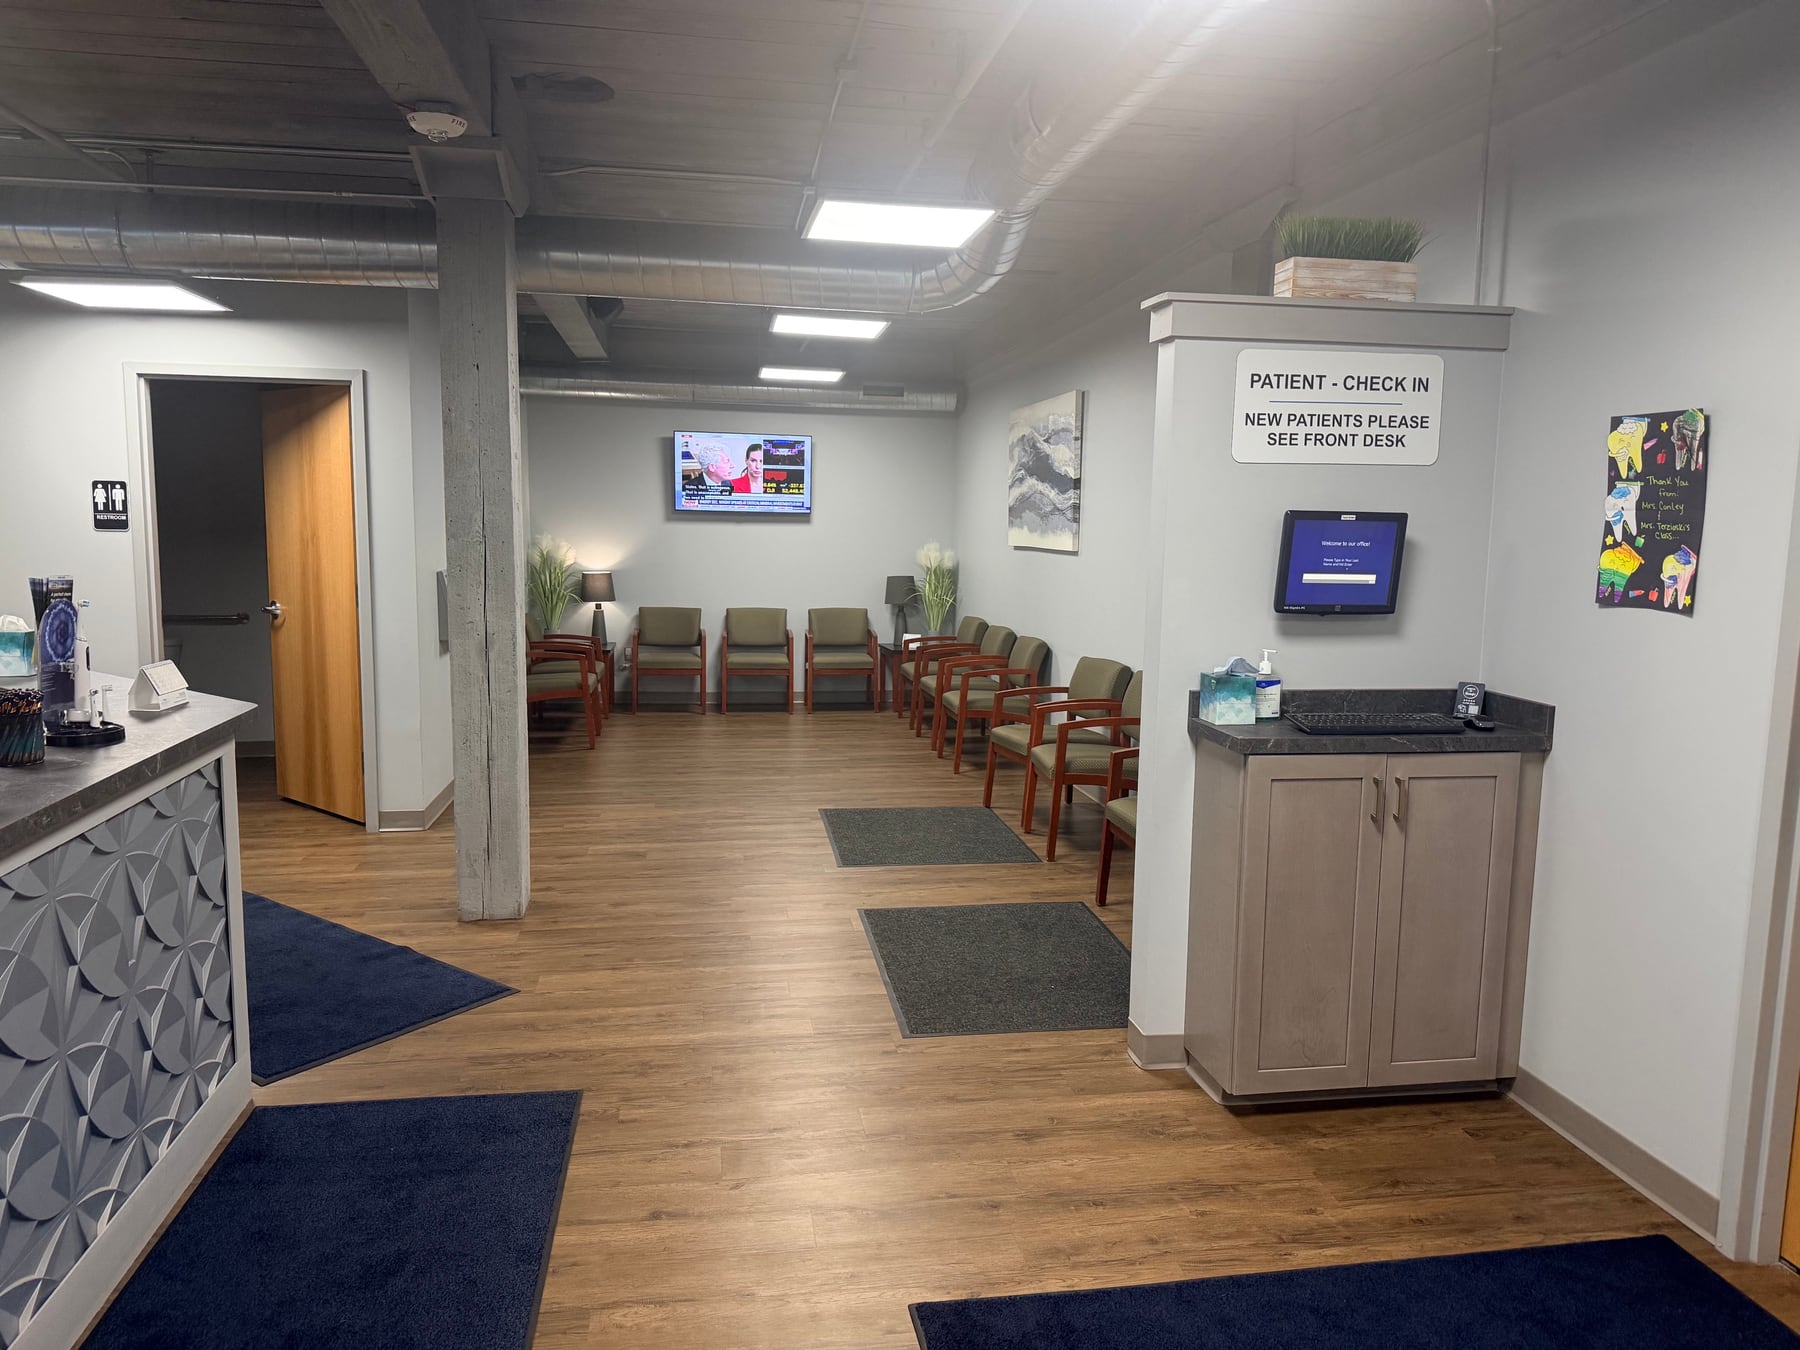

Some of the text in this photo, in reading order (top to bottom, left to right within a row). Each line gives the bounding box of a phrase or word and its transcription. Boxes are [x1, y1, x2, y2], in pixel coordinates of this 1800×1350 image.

[1250, 373, 1327, 390] PATIENT
[1343, 375, 1407, 392] CHECK
[1412, 377, 1429, 392] IN
[1245, 412, 1430, 429] NEW PATIENTS PLEASE
[1267, 433, 1406, 448] SEE FRONT DESK
[1646, 475, 1689, 486] Thank You
